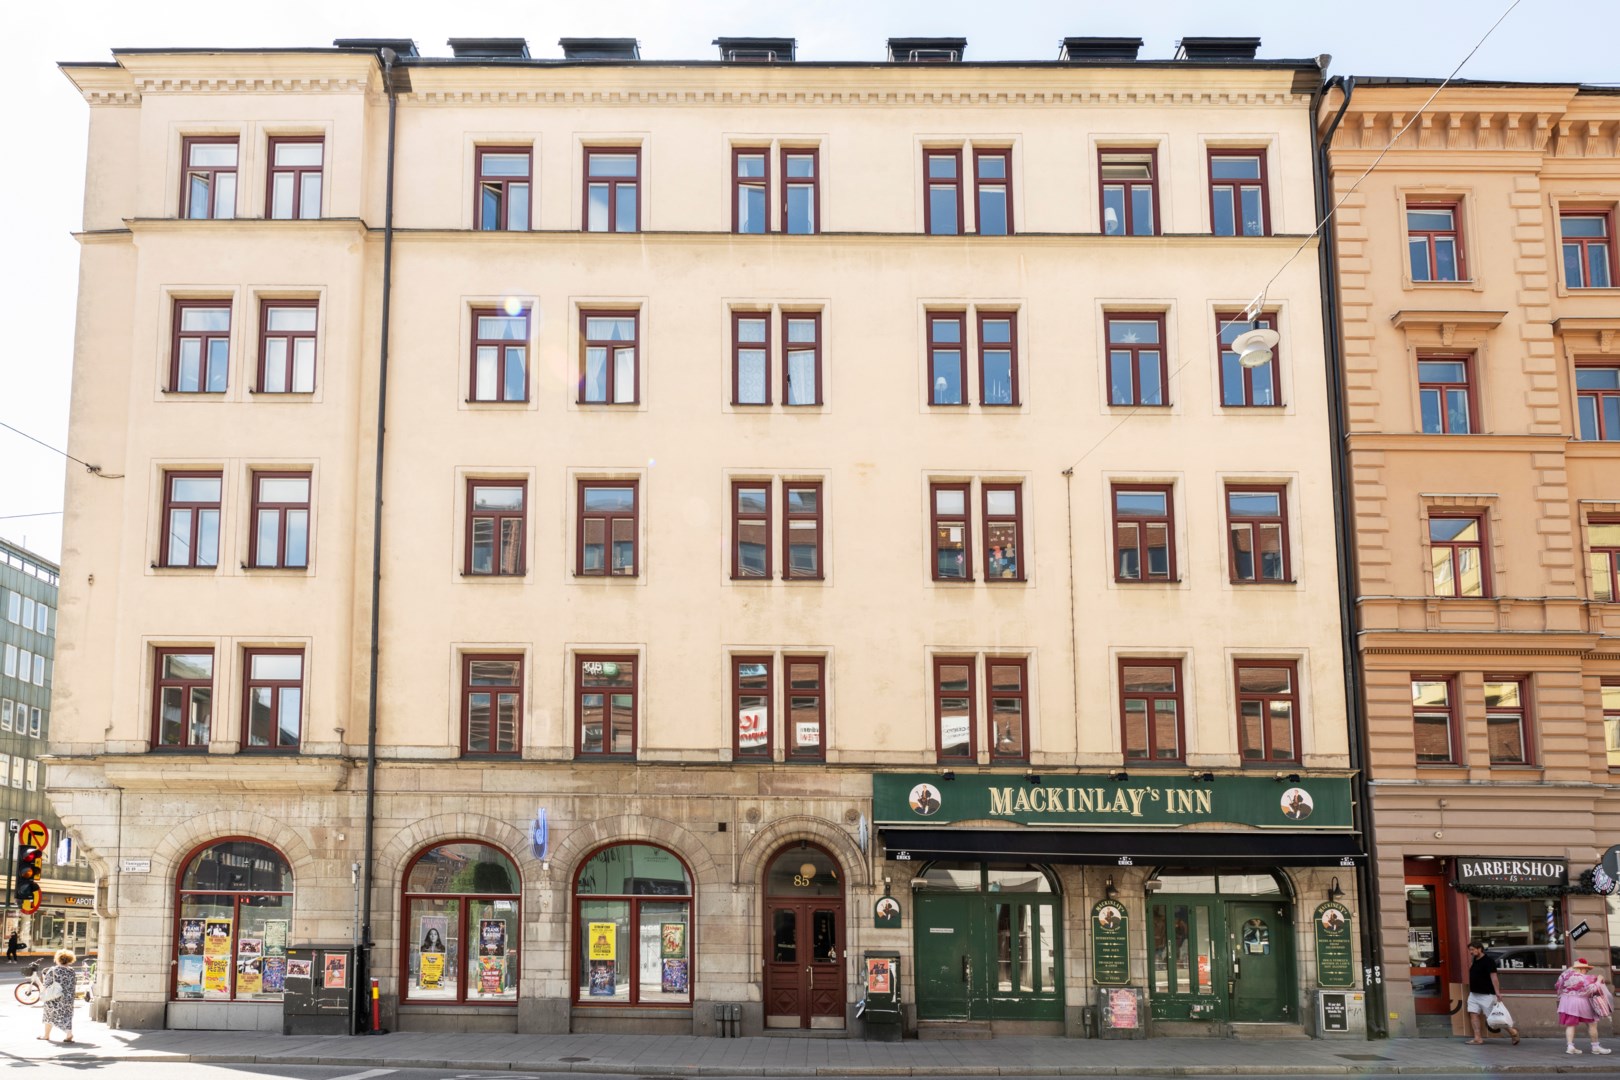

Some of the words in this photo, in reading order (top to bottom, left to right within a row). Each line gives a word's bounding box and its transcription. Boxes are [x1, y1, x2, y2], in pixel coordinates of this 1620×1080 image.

[1165, 789, 1213, 814] INN
[1462, 861, 1564, 878] BARBERSHOP
[794, 874, 810, 886] 85
